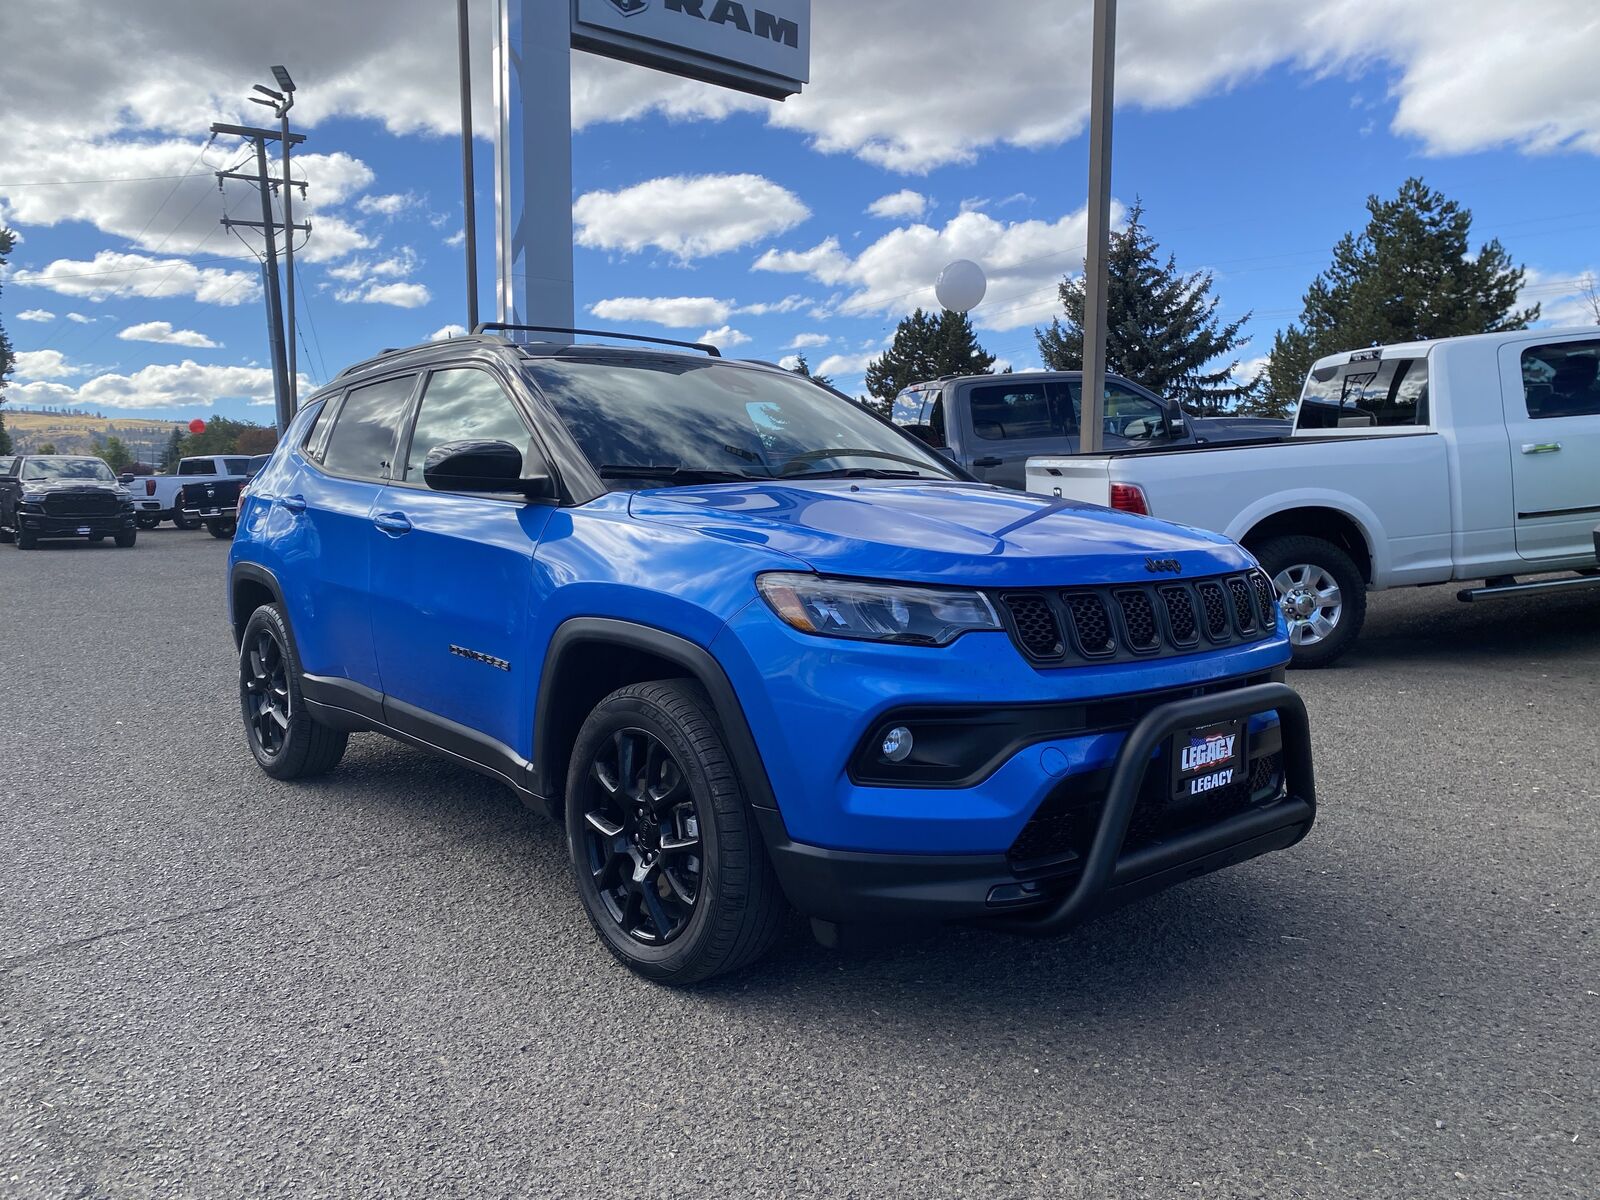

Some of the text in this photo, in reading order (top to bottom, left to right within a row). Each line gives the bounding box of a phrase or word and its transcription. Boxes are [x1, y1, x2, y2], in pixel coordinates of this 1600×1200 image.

[664, 0, 798, 49] RAM
[1181, 736, 1235, 770] LEGACY
[1191, 769, 1233, 794] LEGACY
